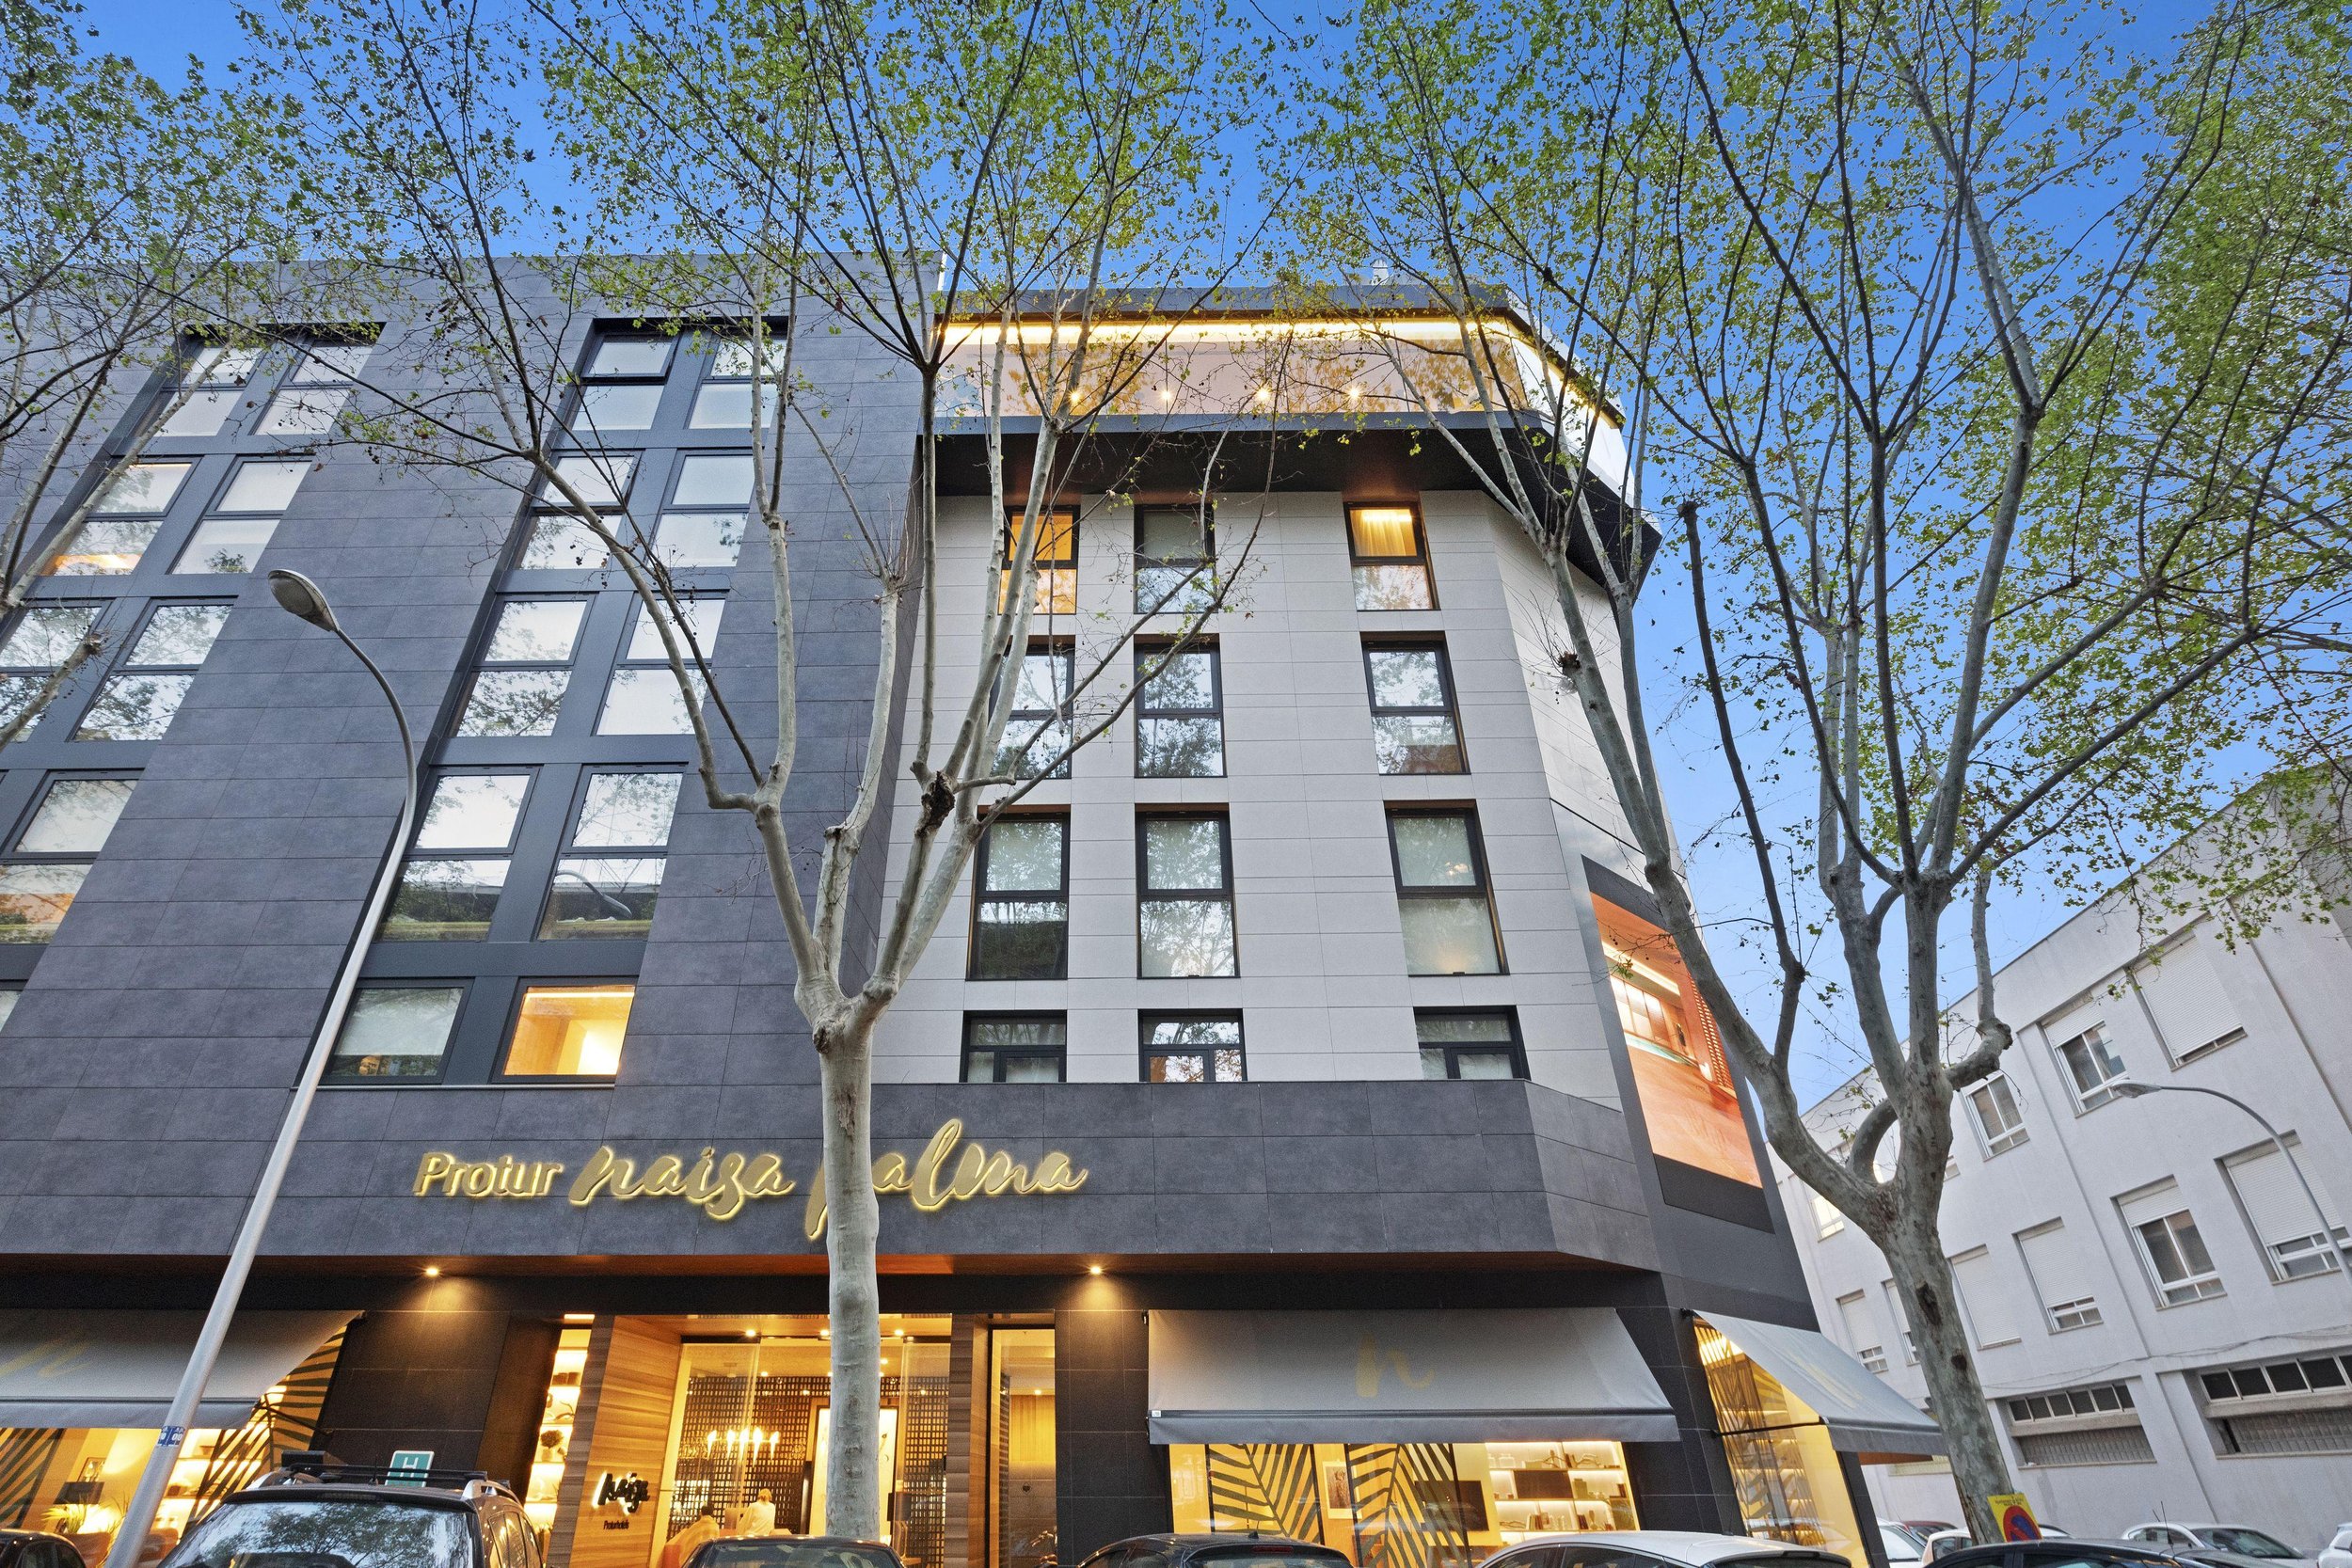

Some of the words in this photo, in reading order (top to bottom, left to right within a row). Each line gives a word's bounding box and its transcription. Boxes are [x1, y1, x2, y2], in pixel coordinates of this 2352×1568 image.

[412, 1151, 564, 1196] Protur
[568, 1145, 795, 1220] naisa
[804, 1118, 1089, 1240] alma
[399, 1456, 420, 1478] H
